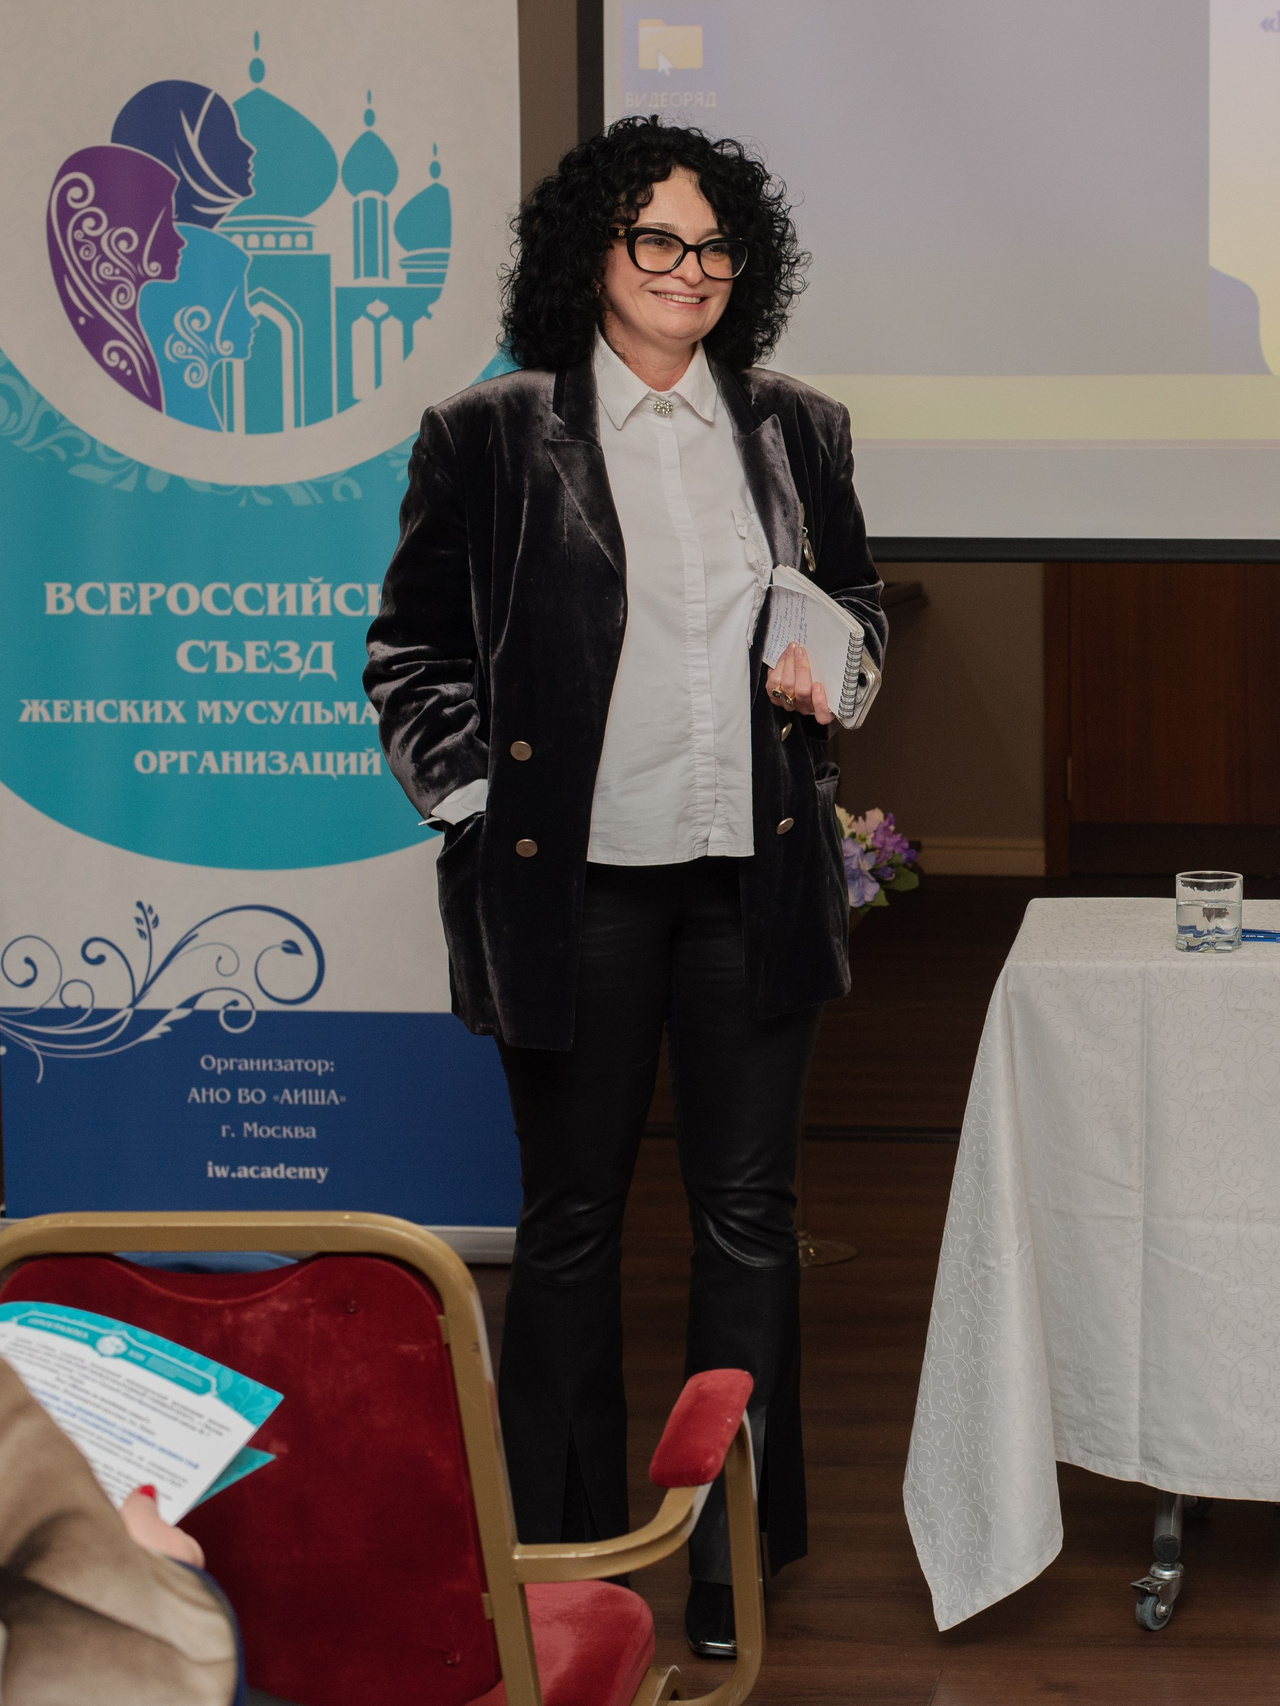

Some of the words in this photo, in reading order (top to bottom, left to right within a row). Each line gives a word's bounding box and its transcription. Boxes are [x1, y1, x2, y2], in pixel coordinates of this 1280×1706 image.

[624, 91, 717, 109] ВИДЕОРЯД
[176, 639, 338, 682] СЪЕЗД
[18, 699, 187, 724] ЖЕНСКИХ
[199, 701, 380, 725] МУСУЛЬМА
[134, 747, 383, 781] ОРГАНИЗАЦИЙ
[200, 1054, 335, 1077] Организатор:
[187, 1087, 231, 1104] АНО
[237, 1088, 267, 1105] ВО
[272, 1088, 347, 1106] «АИША»
[221, 1124, 236, 1138] г.
[243, 1121, 317, 1139] Москва
[206, 1160, 329, 1184] iw.academy
